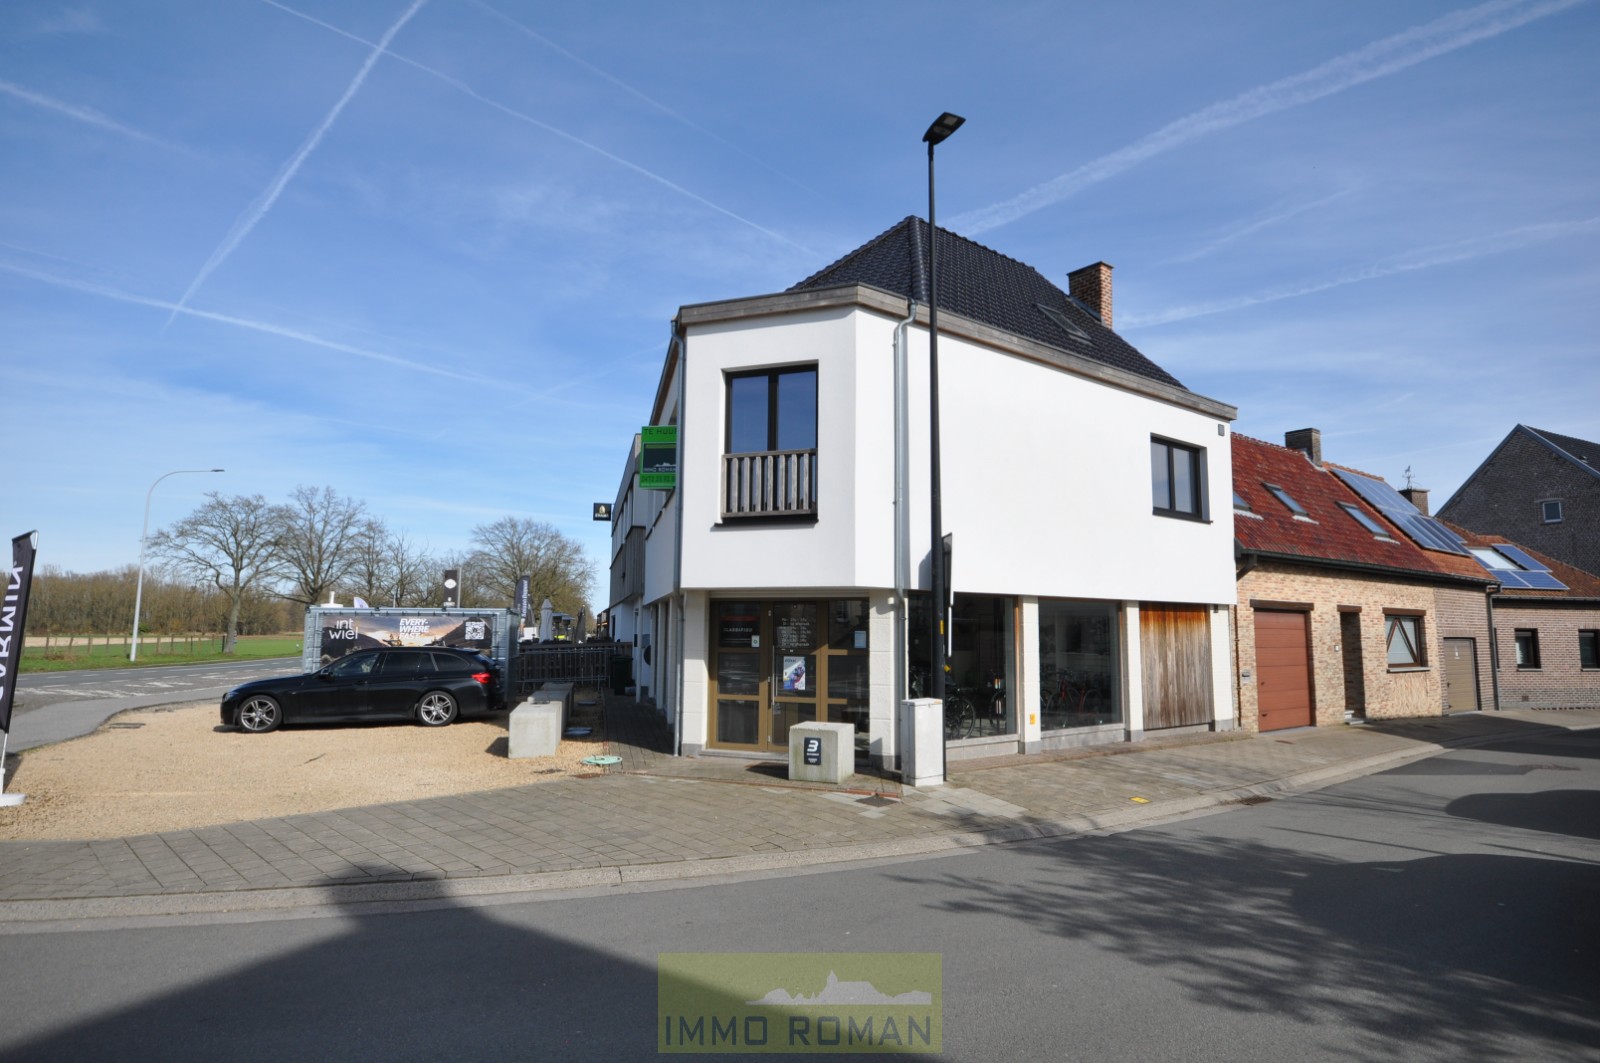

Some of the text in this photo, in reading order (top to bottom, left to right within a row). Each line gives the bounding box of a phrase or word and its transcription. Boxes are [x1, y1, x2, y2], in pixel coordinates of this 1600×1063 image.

[399, 618, 429, 626] EVERY-
[328, 626, 359, 640] wiel
[399, 625, 430, 633] WHERE
